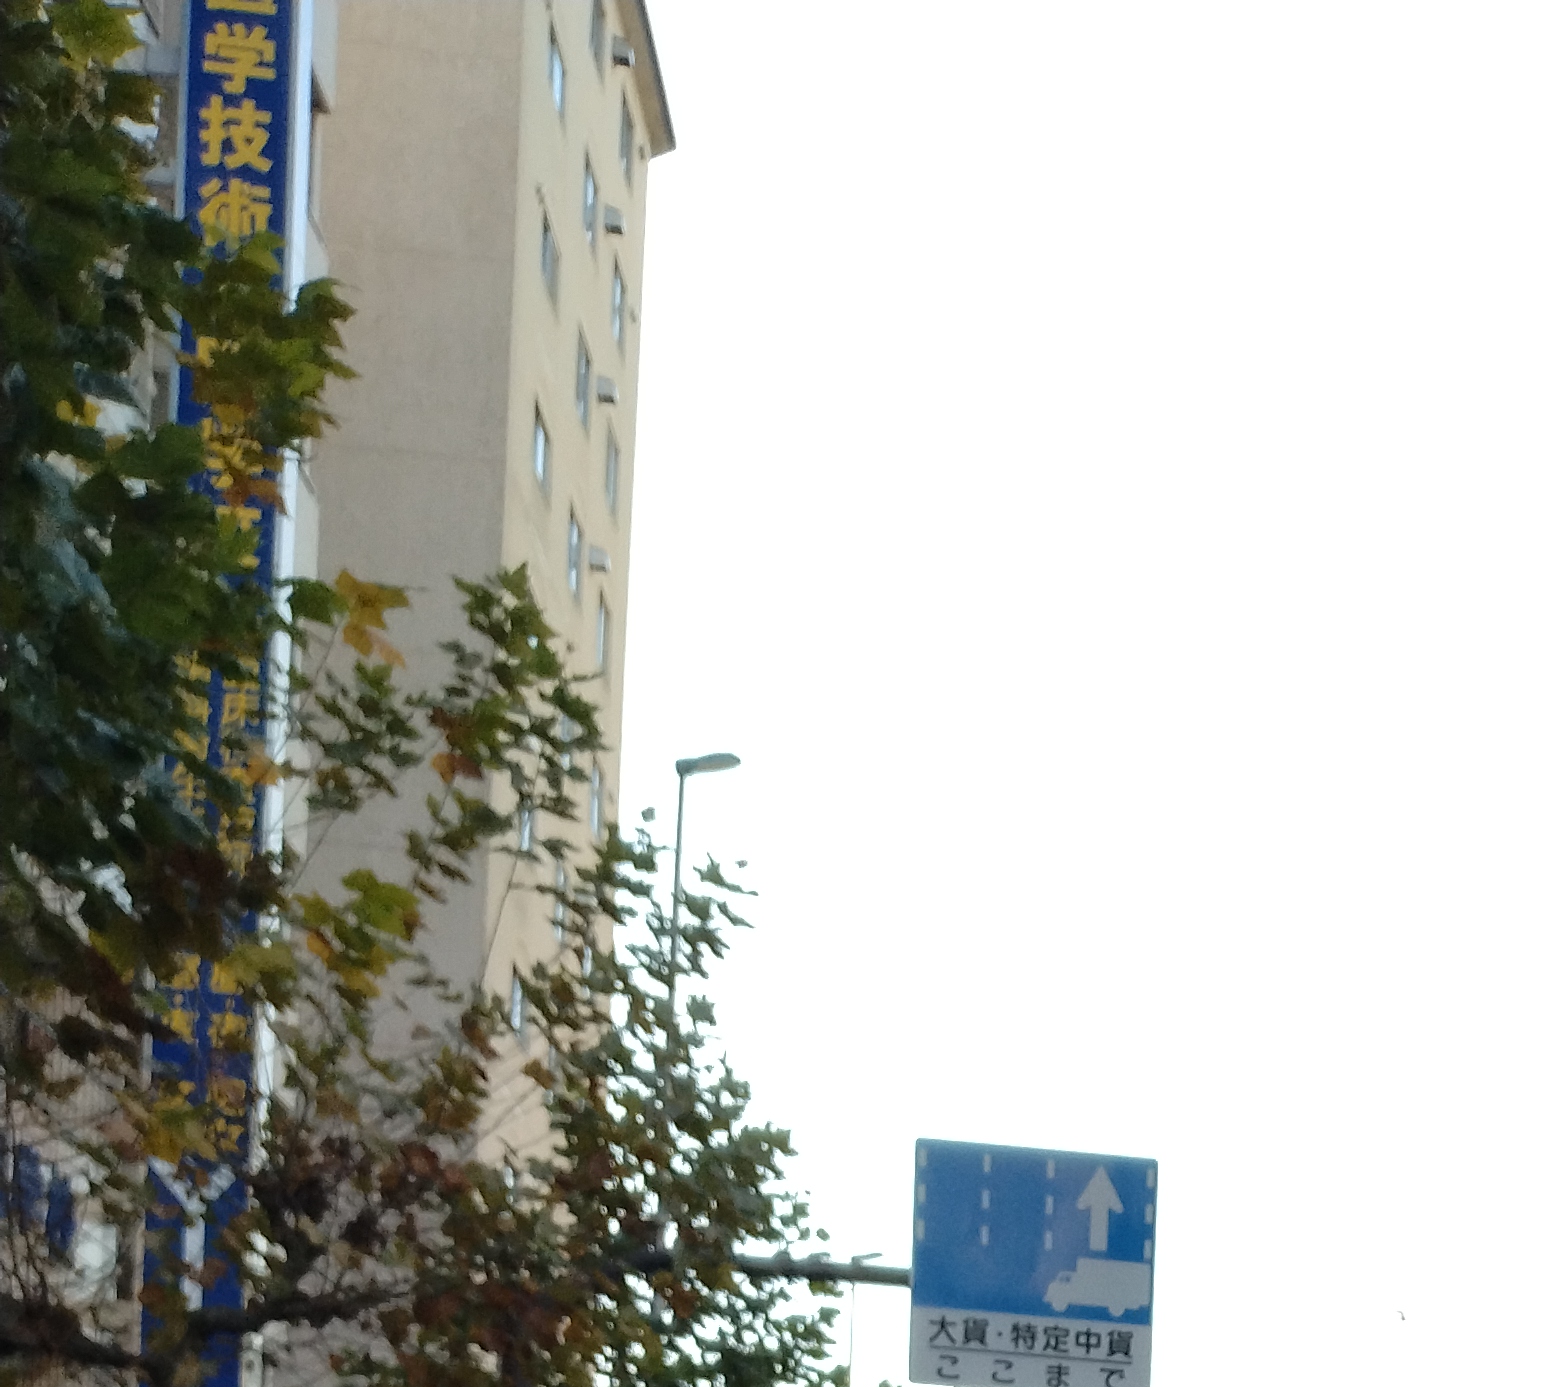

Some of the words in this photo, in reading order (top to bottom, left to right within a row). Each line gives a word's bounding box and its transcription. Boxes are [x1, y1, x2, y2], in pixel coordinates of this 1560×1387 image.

[929, 1315, 1134, 1358] 大貨・特定中貨
